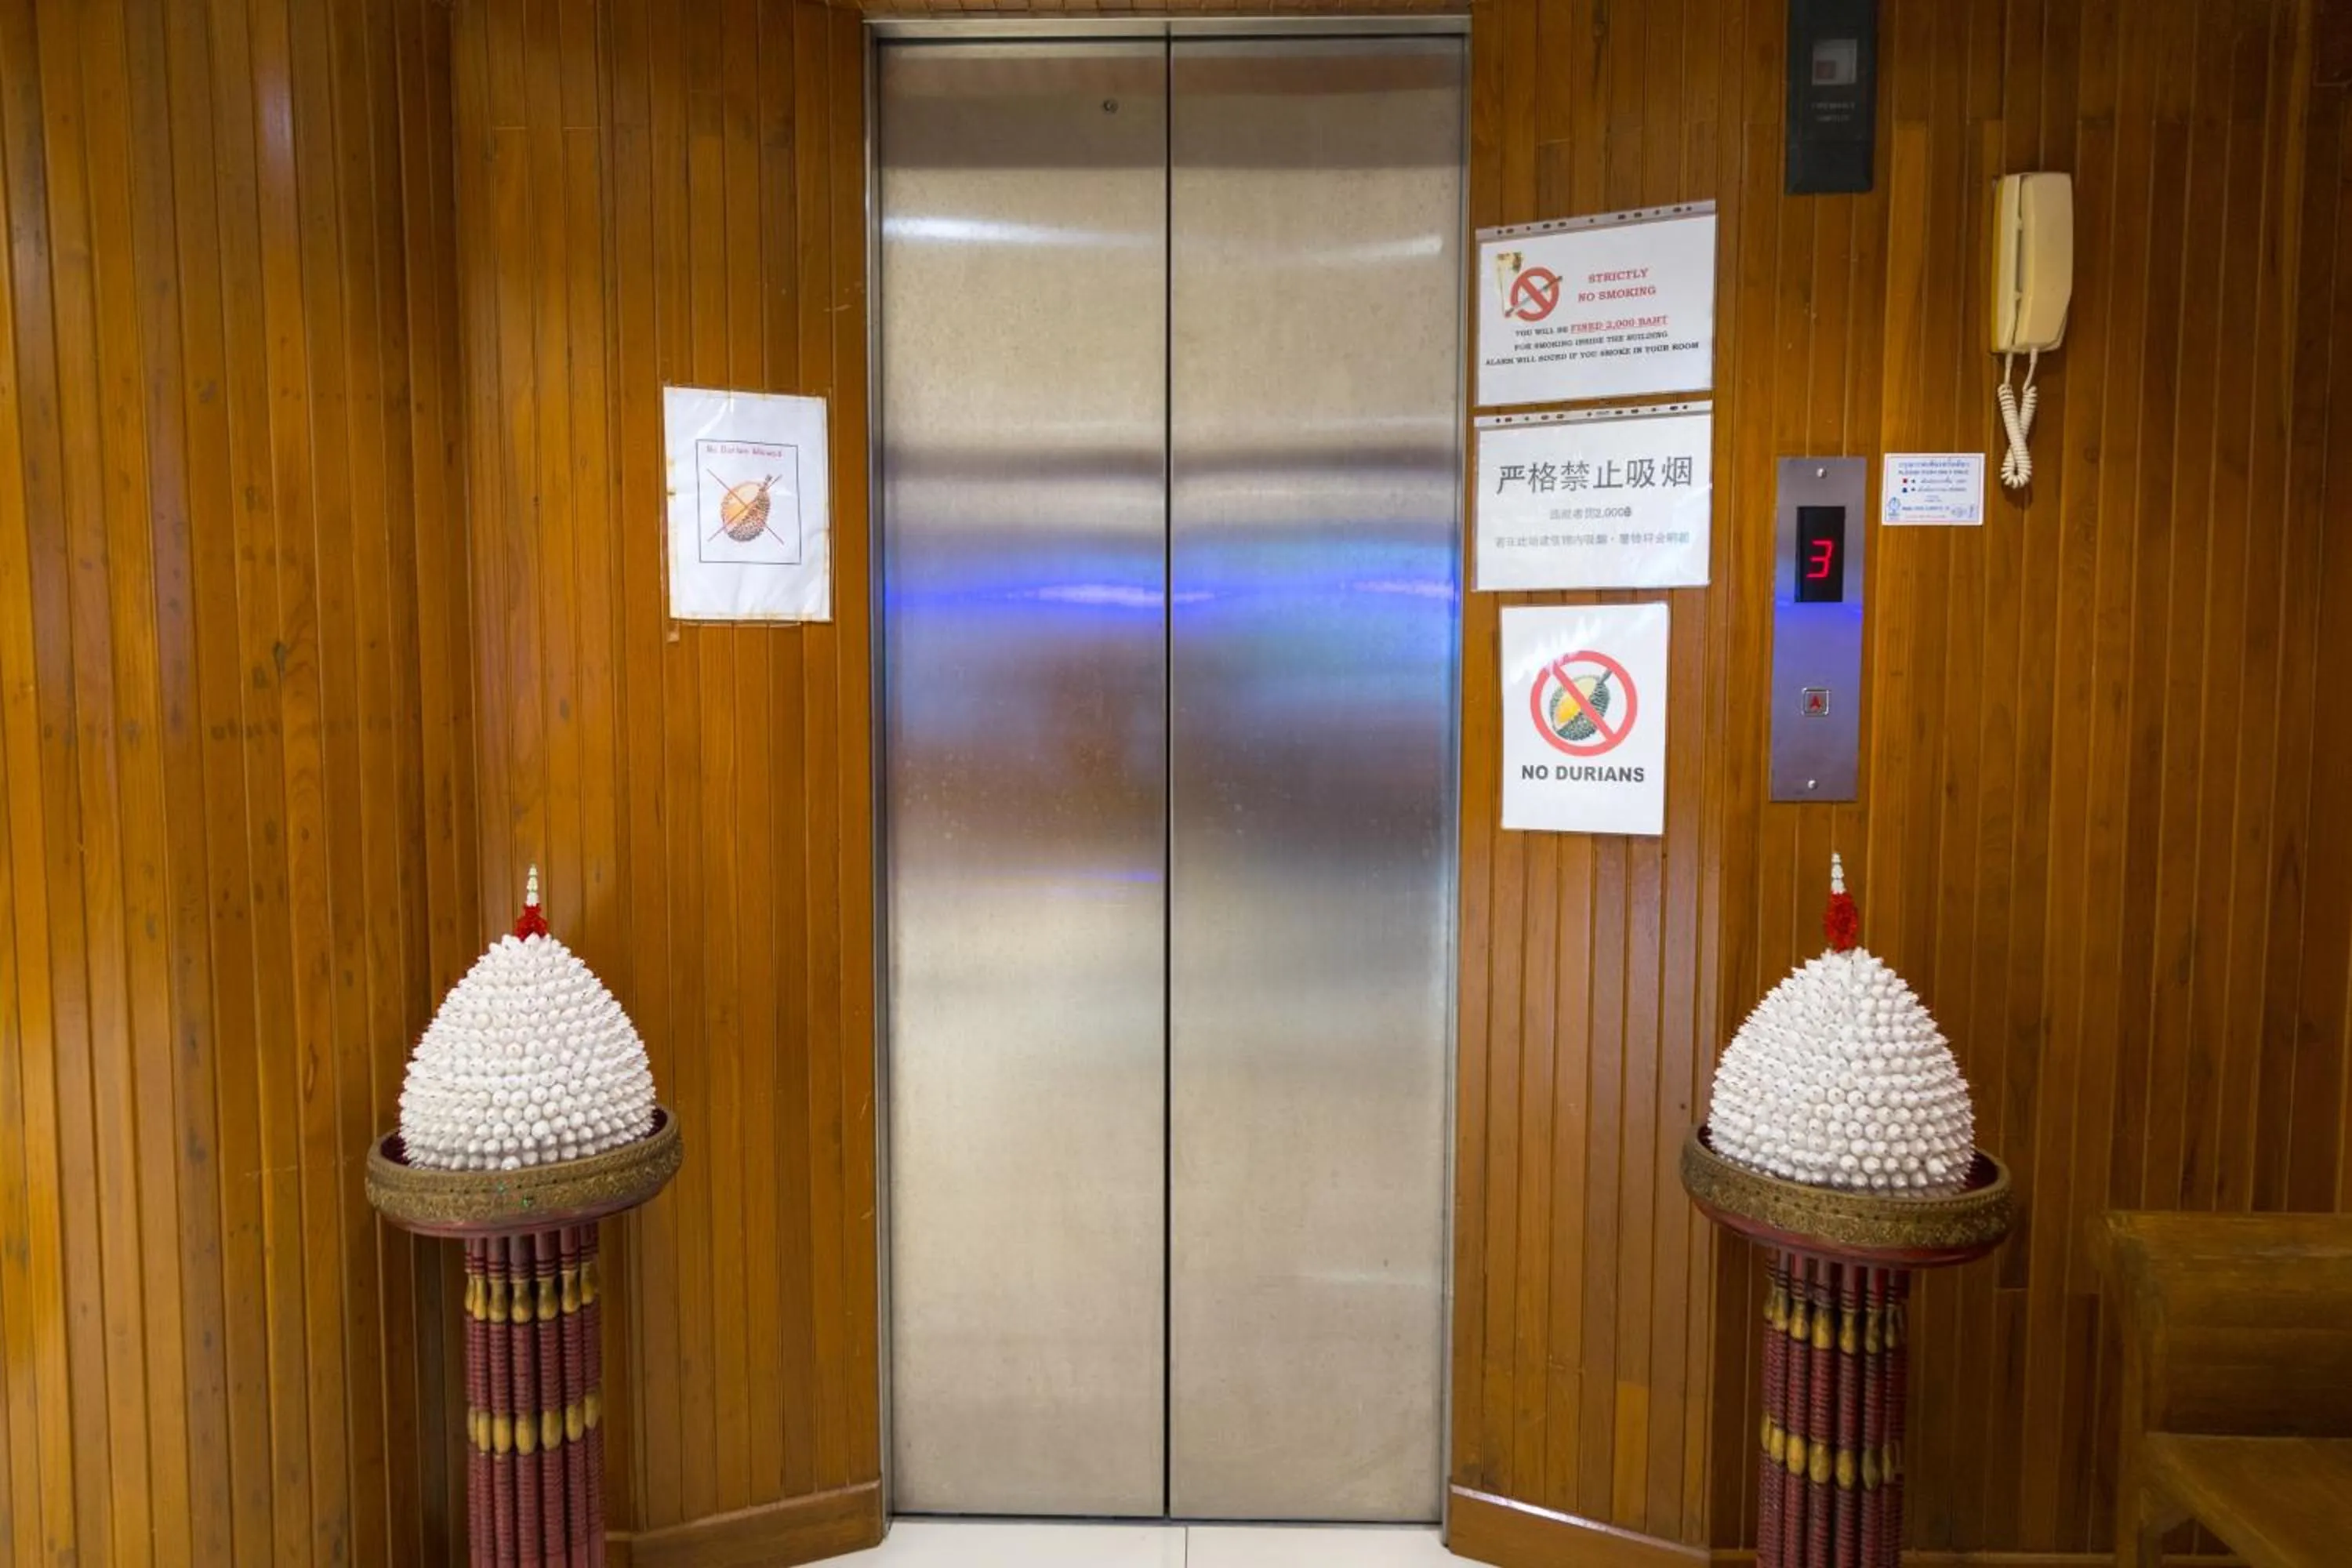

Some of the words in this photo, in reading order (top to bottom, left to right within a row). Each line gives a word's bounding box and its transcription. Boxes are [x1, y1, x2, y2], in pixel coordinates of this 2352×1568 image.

[1588, 267, 1649, 284] STRICTLY
[1578, 292, 1595, 303] NO
[1598, 285, 1657, 301] SMOKING
[1534, 328, 1554, 336] WILL
[1570, 322, 1603, 334] FINED
[1605, 318, 1635, 330] 2,000
[1638, 314, 1669, 327] BAHT
[1515, 343, 1532, 351] FOR
[1534, 339, 1573, 350] SMOKING
[1575, 336, 1604, 346] INSIDE
[1606, 334, 1624, 343] THE
[1625, 330, 1668, 341] BUILDING
[1486, 357, 1514, 365] ALARM
[1537, 353, 1567, 362] SOUND
[1579, 350, 1597, 359] YOU
[1599, 347, 1632, 358] SMOKE
[1645, 344, 1669, 354] YOUR
[1671, 341, 1700, 351] ROOM
[1496, 456, 1693, 495] 严格禁止吸烟
[1806, 540, 1833, 579] 3
[1522, 764, 1548, 780] NO
[1555, 765, 1645, 782] DURIANS
